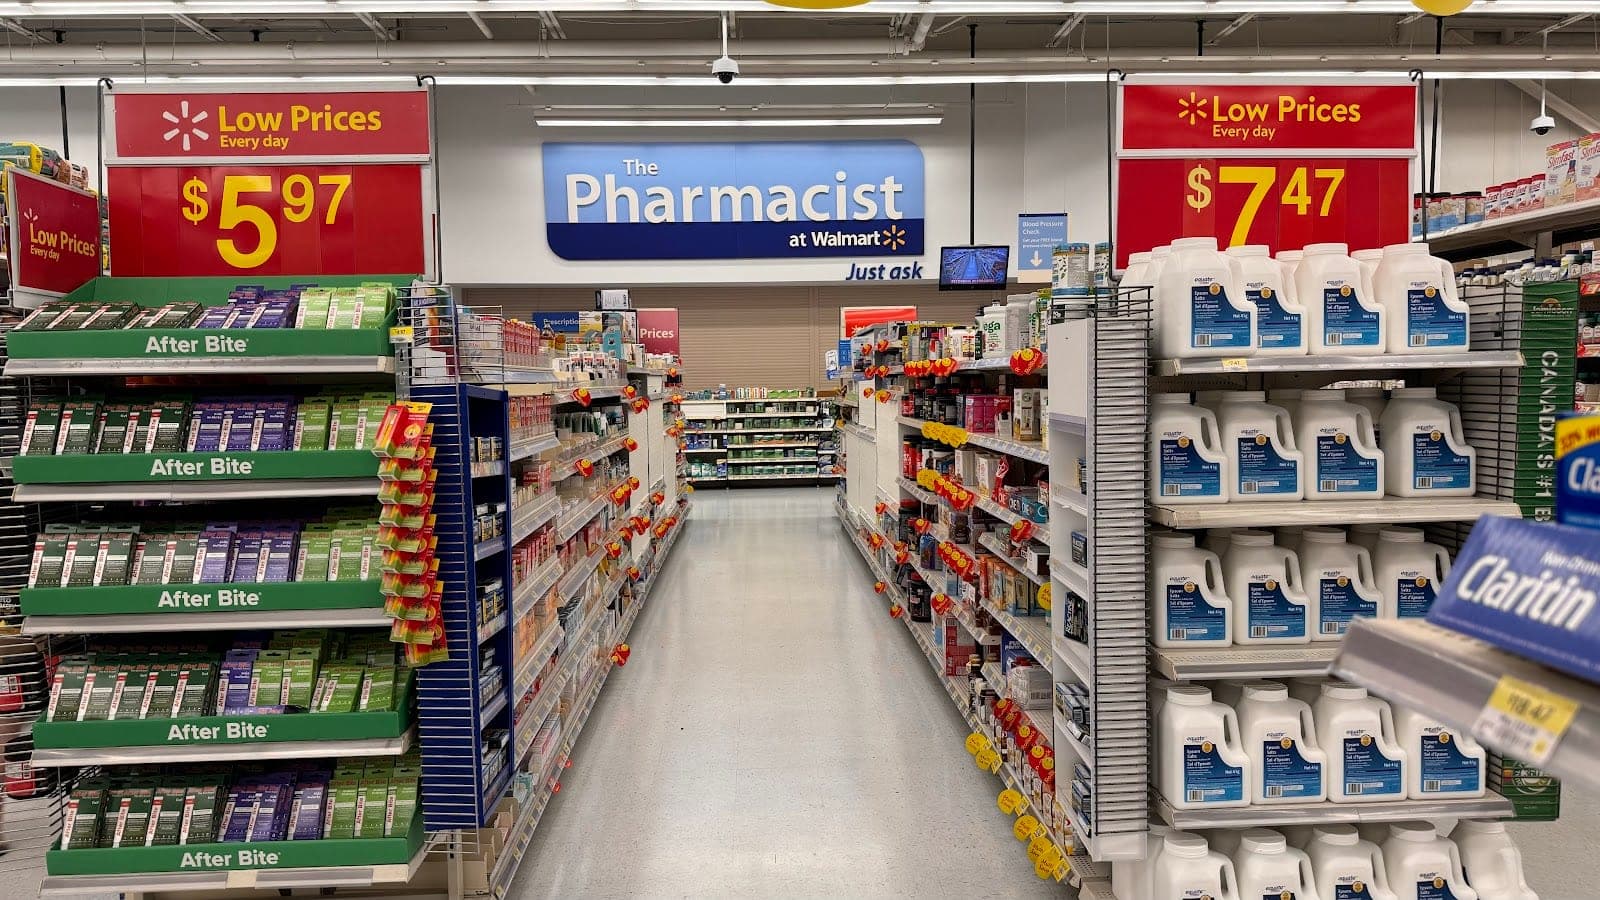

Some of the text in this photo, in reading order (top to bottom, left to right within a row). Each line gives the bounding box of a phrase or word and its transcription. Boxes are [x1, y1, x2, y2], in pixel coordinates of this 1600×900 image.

[218, 105, 382, 132] Low Prices
[1213, 96, 1361, 123] Low Prices
[1213, 125, 1276, 141] Every day
[220, 134, 289, 151] Every day
[623, 159, 658, 176] The
[565, 171, 903, 224] Pharmacist
[30, 223, 95, 257] Low Prices
[789, 231, 880, 247] at Walmart
[30, 244, 60, 262] Every day
[846, 261, 922, 281] Just ask
[543, 318, 579, 328] Pescriptio
[640, 328, 674, 339] Prices
[146, 335, 247, 353] After Bite
[150, 457, 252, 475] After Bite
[158, 589, 259, 607] After Bite
[1456, 554, 1597, 632] Claritin
[168, 721, 267, 740] After Bite
[180, 850, 279, 867] After Bite
